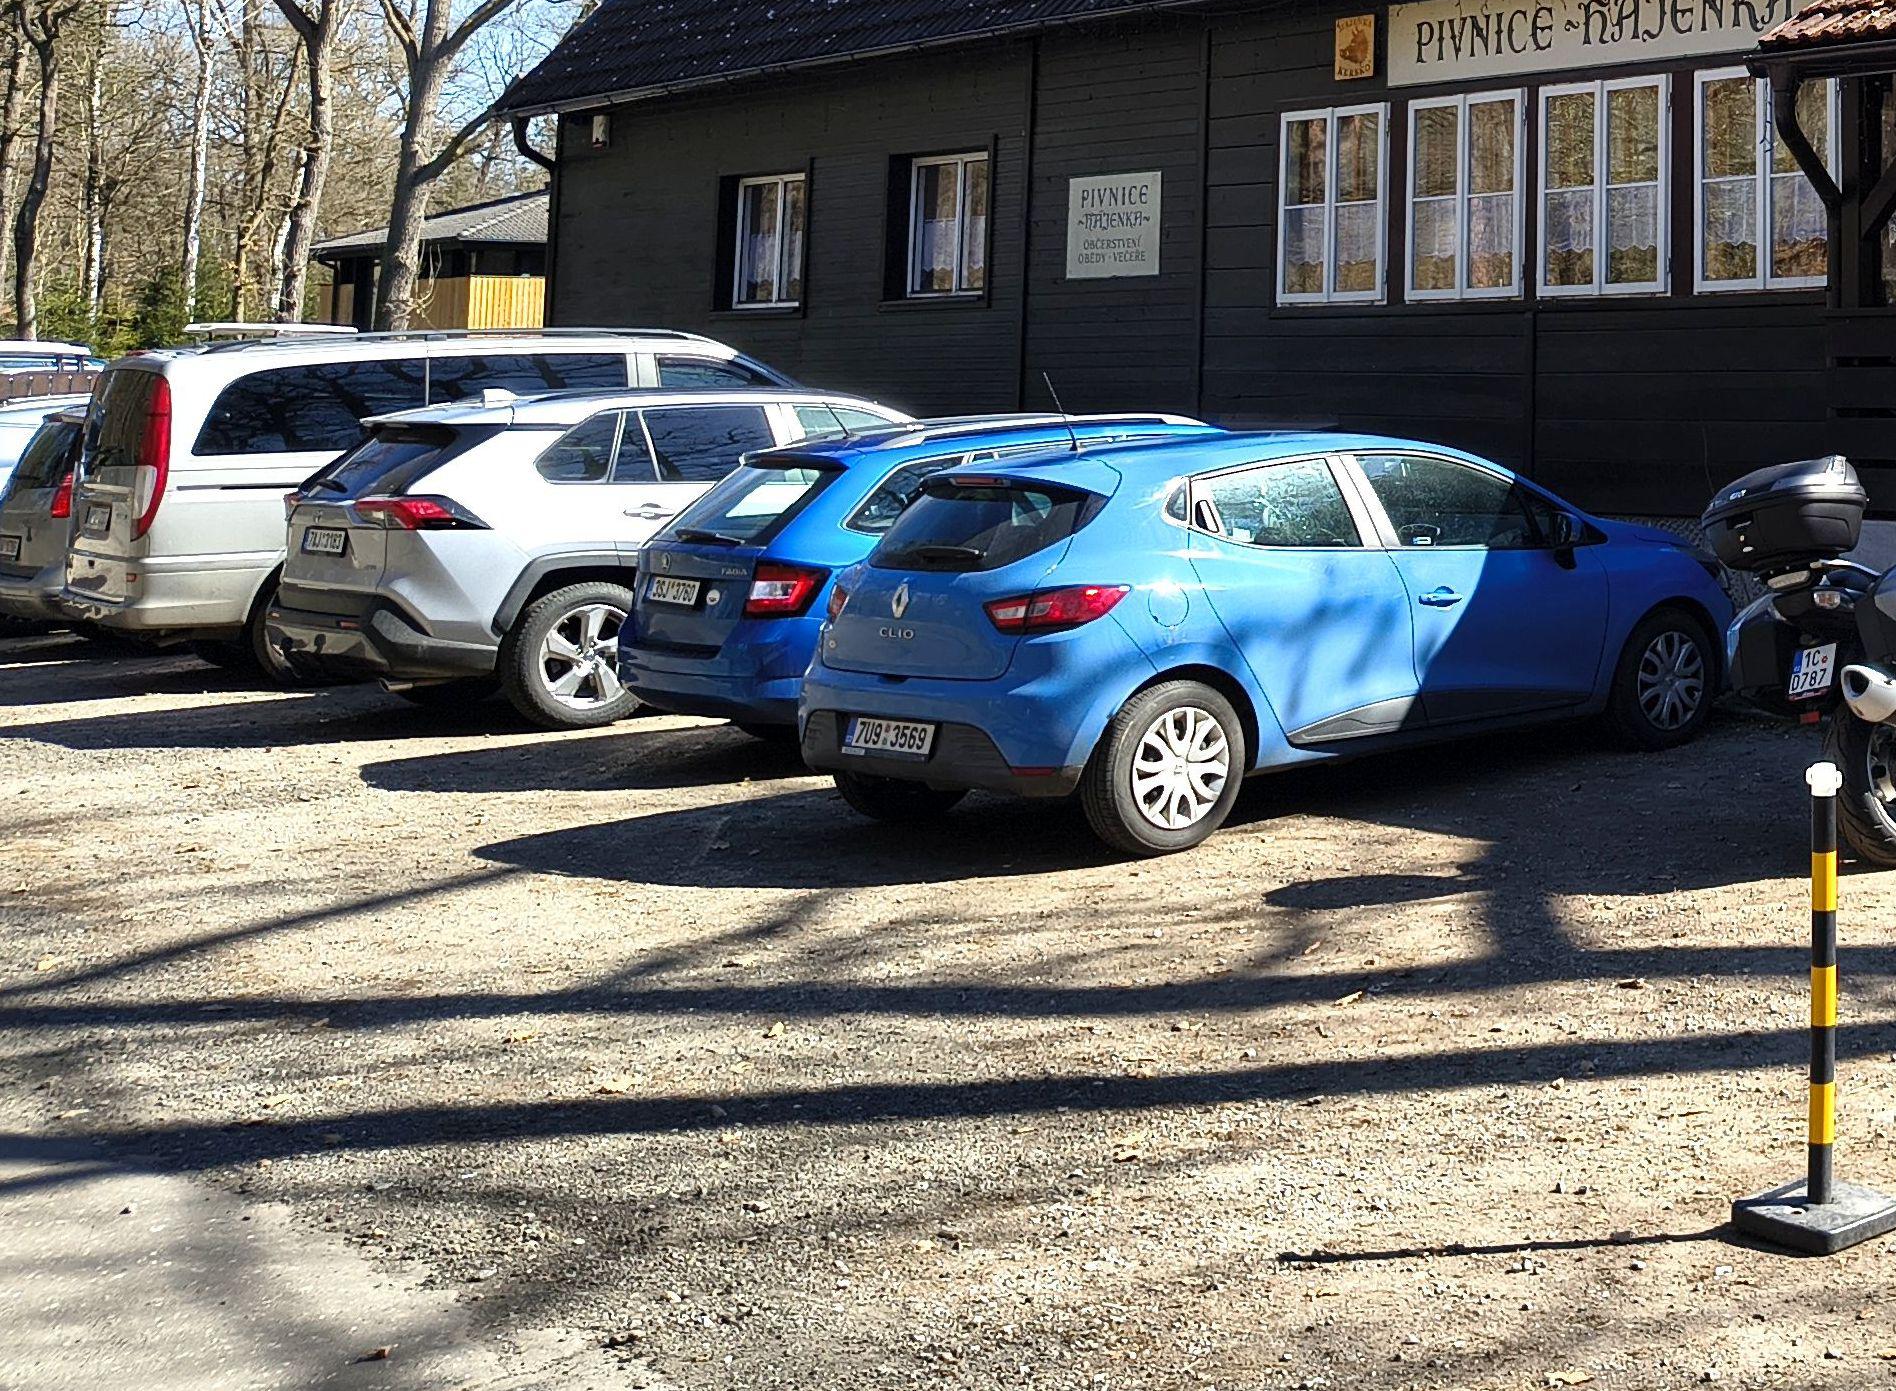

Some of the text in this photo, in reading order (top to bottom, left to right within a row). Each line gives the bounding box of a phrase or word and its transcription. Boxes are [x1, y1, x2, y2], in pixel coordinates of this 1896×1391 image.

[1416, 6, 1553, 63] PIVNICE
[1081, 184, 1149, 208] PIVNICE
[1083, 234, 1142, 251] OBČERSTVENÍ
[1113, 249, 1146, 263] VEČEŘE
[672, 581, 696, 602] 3760
[879, 626, 915, 640] CLIO
[1805, 649, 1820, 668] 1C
[854, 720, 928, 751] 7U9 3569
